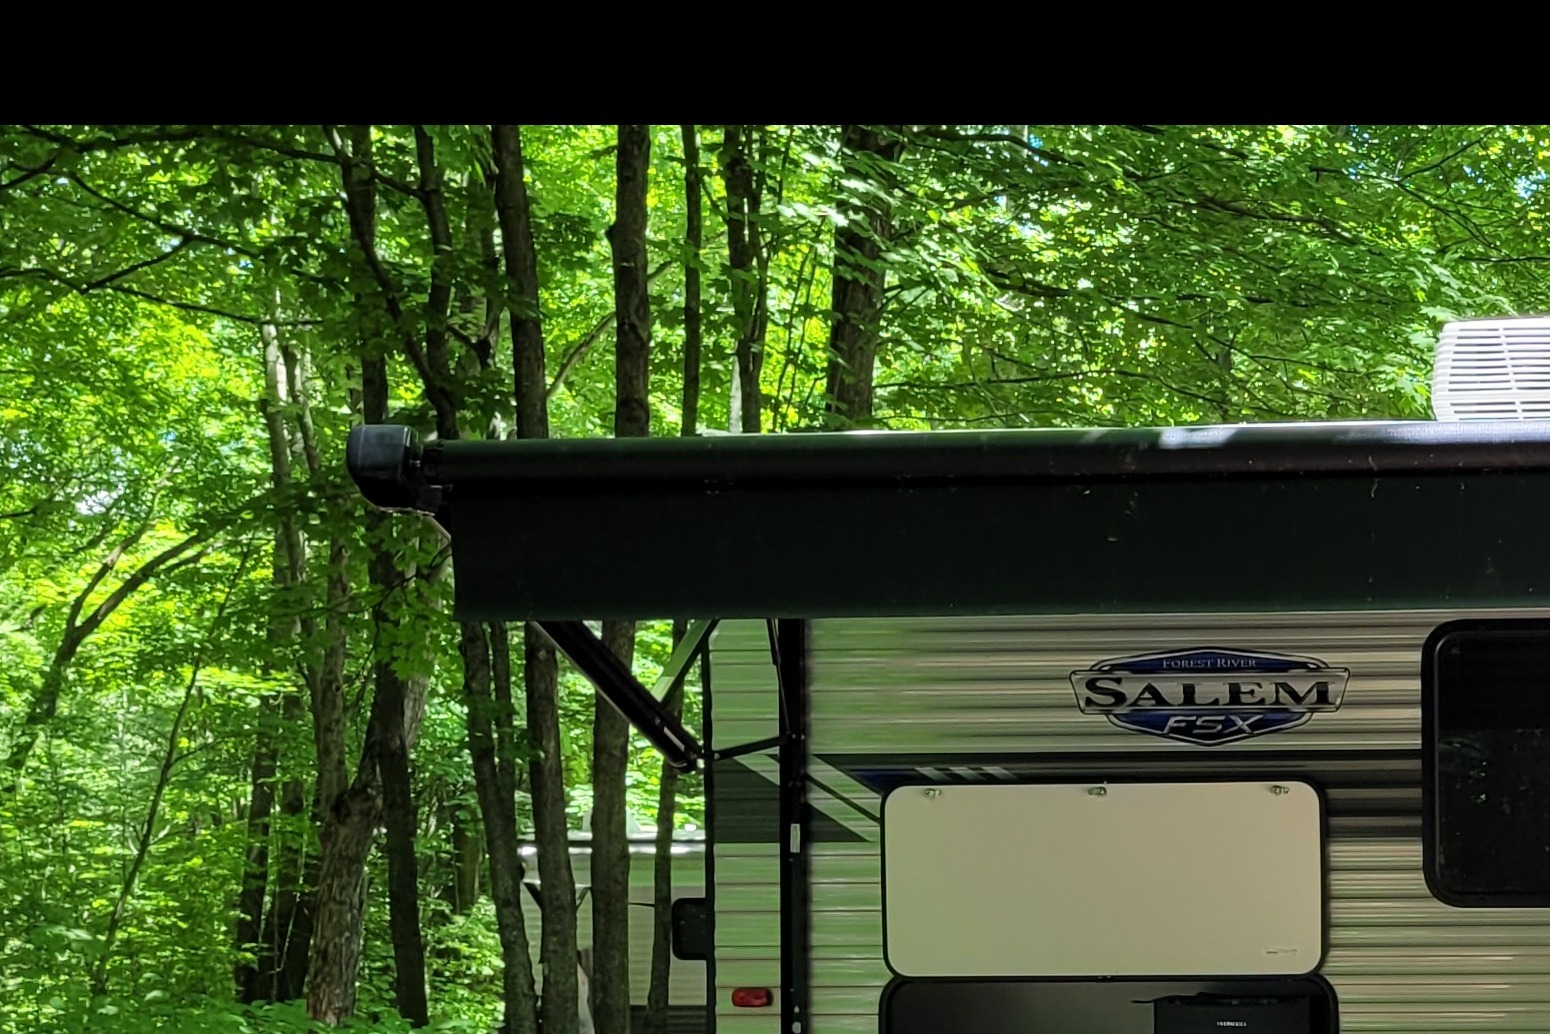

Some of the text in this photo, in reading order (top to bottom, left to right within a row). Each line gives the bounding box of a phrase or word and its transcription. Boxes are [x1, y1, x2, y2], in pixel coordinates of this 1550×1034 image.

[1162, 657, 1257, 668] FOREST RIVER
[1084, 677, 1336, 707] SALEM
[1162, 714, 1264, 734] FSX
